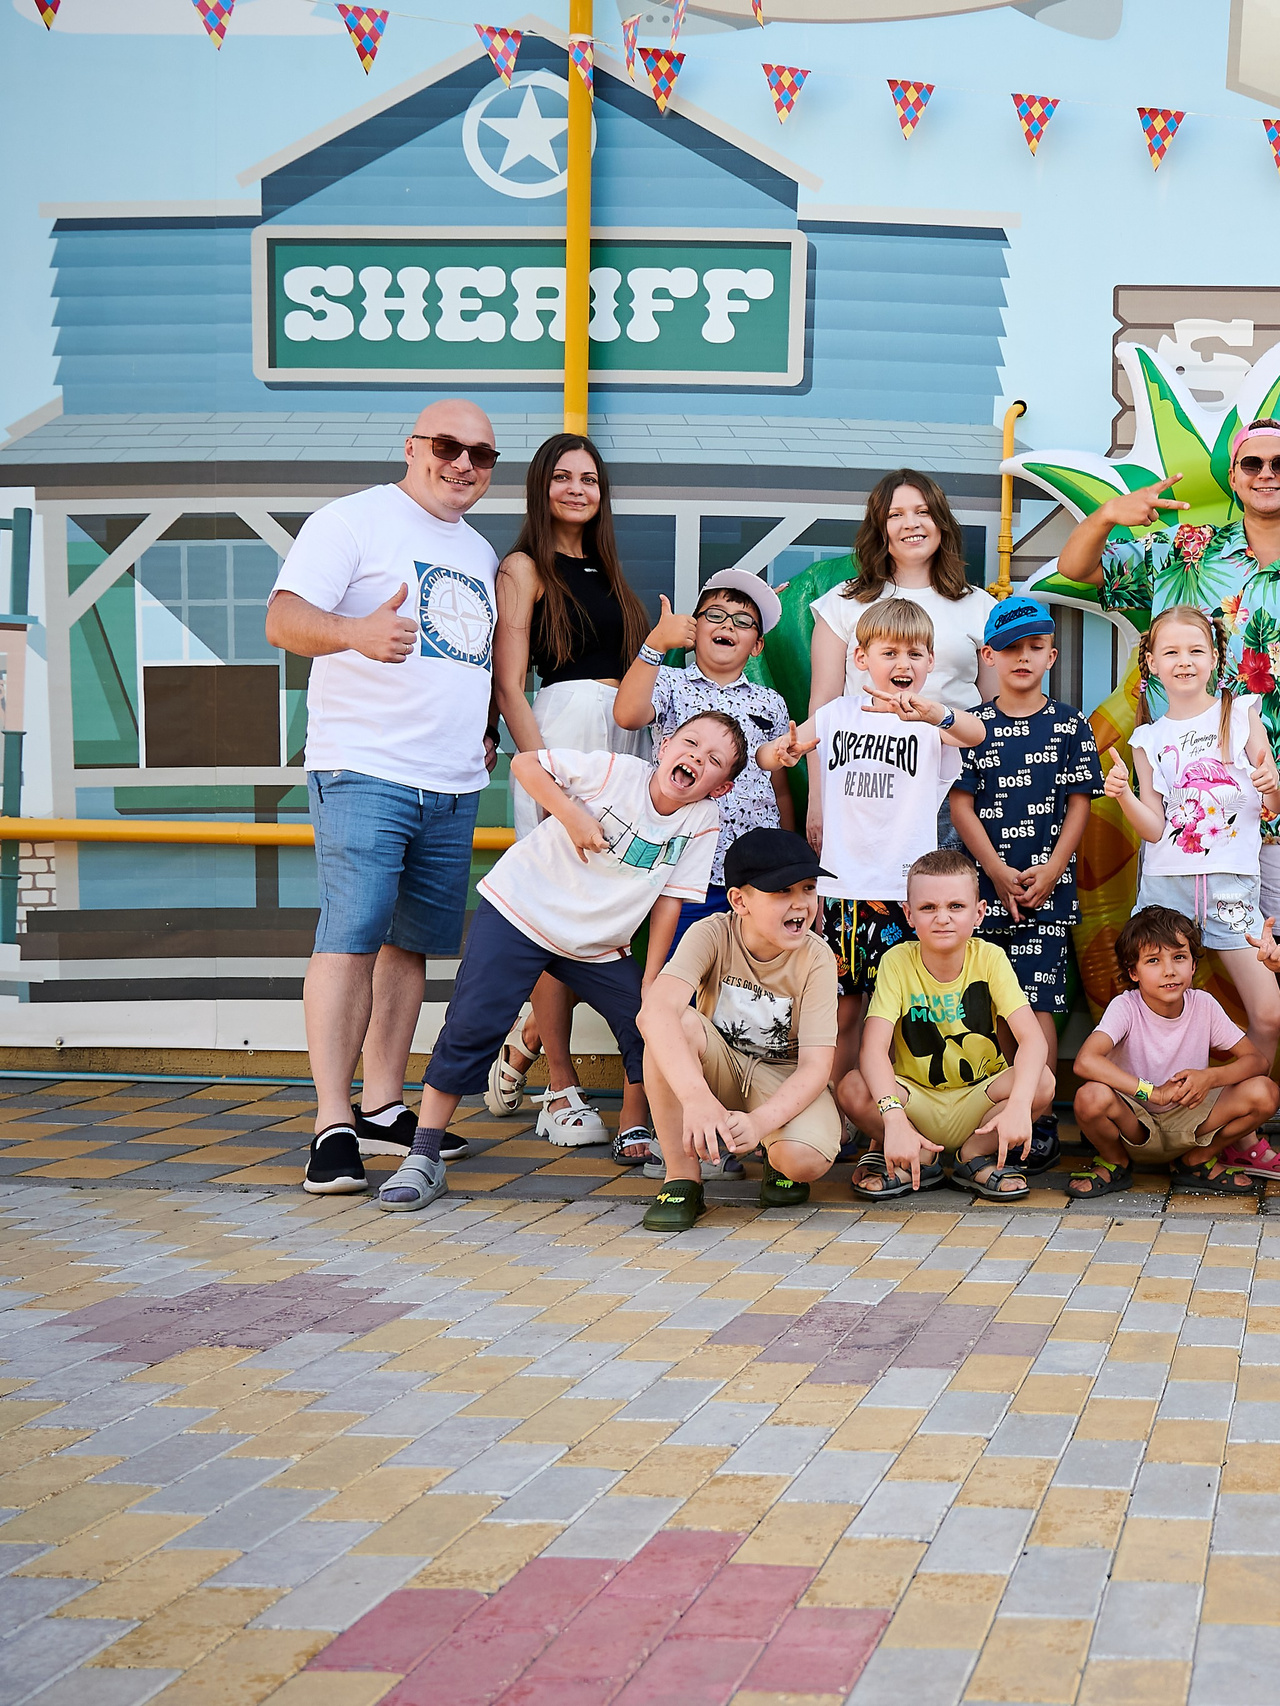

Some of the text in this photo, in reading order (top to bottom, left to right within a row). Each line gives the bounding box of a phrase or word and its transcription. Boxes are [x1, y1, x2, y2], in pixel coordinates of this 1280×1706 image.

[283, 264, 774, 343] SHERIFF
[993, 725, 1030, 737] BOSS
[1179, 730, 1218, 751] Flamingo
[828, 730, 918, 778] SUPERHERO
[1024, 751, 1059, 764] BOSS
[844, 771, 895, 799] BE BRAVE
[998, 774, 1032, 788] BOSS
[1001, 825, 1036, 839] BOSS
[1038, 925, 1066, 938] BOSS
[1010, 944, 1042, 955] BOSS
